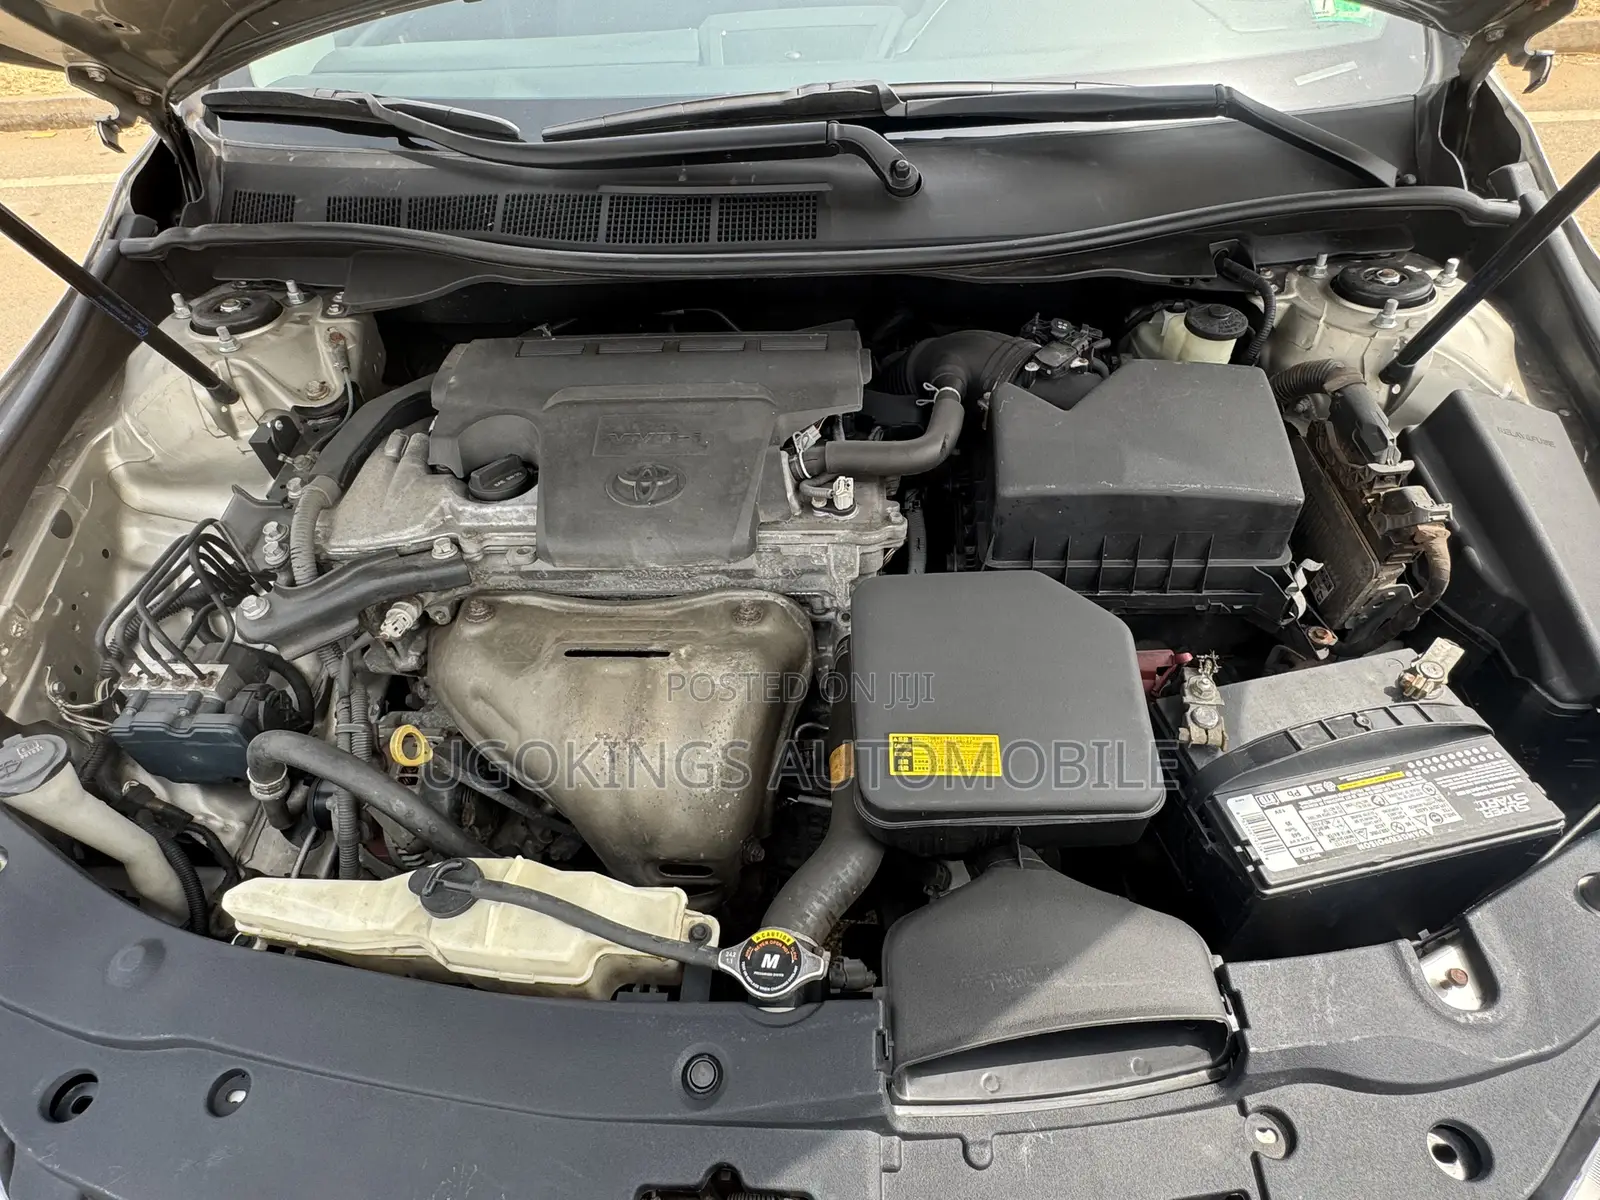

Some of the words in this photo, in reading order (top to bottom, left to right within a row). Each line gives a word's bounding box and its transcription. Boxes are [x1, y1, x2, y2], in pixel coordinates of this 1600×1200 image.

[1286, 789, 1301, 797] Pb
[1475, 792, 1530, 811] START
[1481, 804, 1531, 819] SUPER
[761, 931, 791, 943] CAUTION
[761, 953, 780, 969] M
